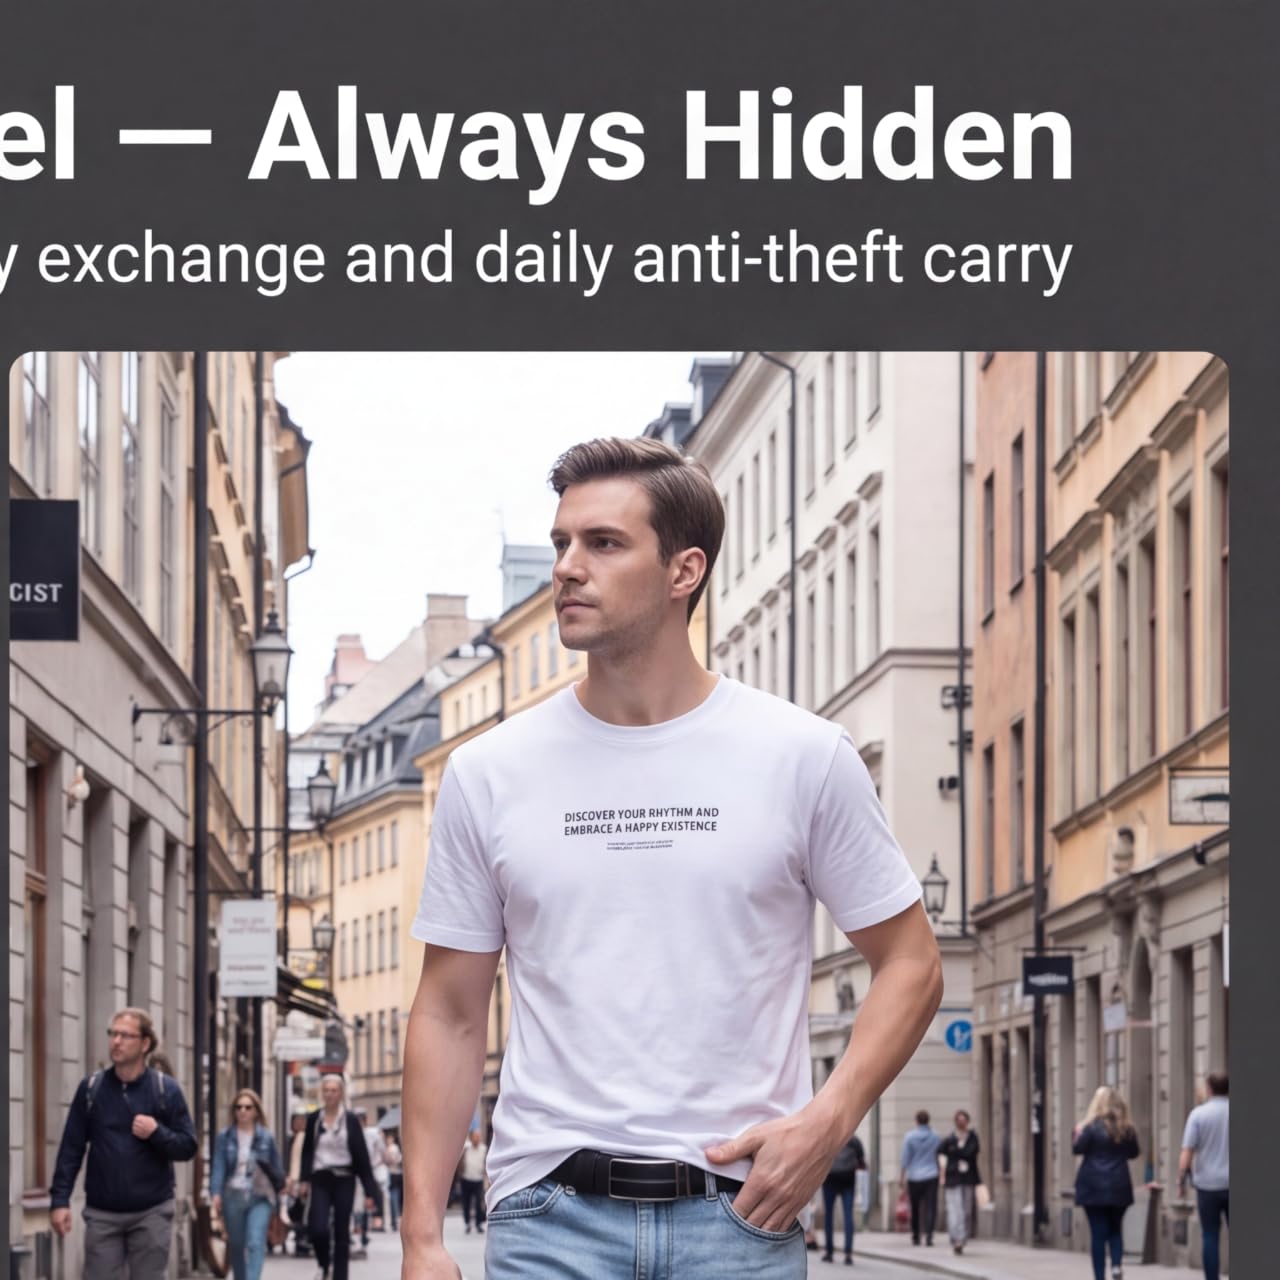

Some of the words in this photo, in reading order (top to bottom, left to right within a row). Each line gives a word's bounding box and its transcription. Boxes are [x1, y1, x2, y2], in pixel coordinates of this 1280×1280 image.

[564, 810, 616, 823] DISCOVER
[618, 808, 646, 819] YOUR
[648, 807, 693, 818] RHYTHM
[696, 807, 719, 817] AND
[564, 824, 613, 836] EMBRACE
[615, 823, 622, 833] A
[625, 822, 659, 833] HAPPY
[661, 821, 717, 832] EXISTENCE
